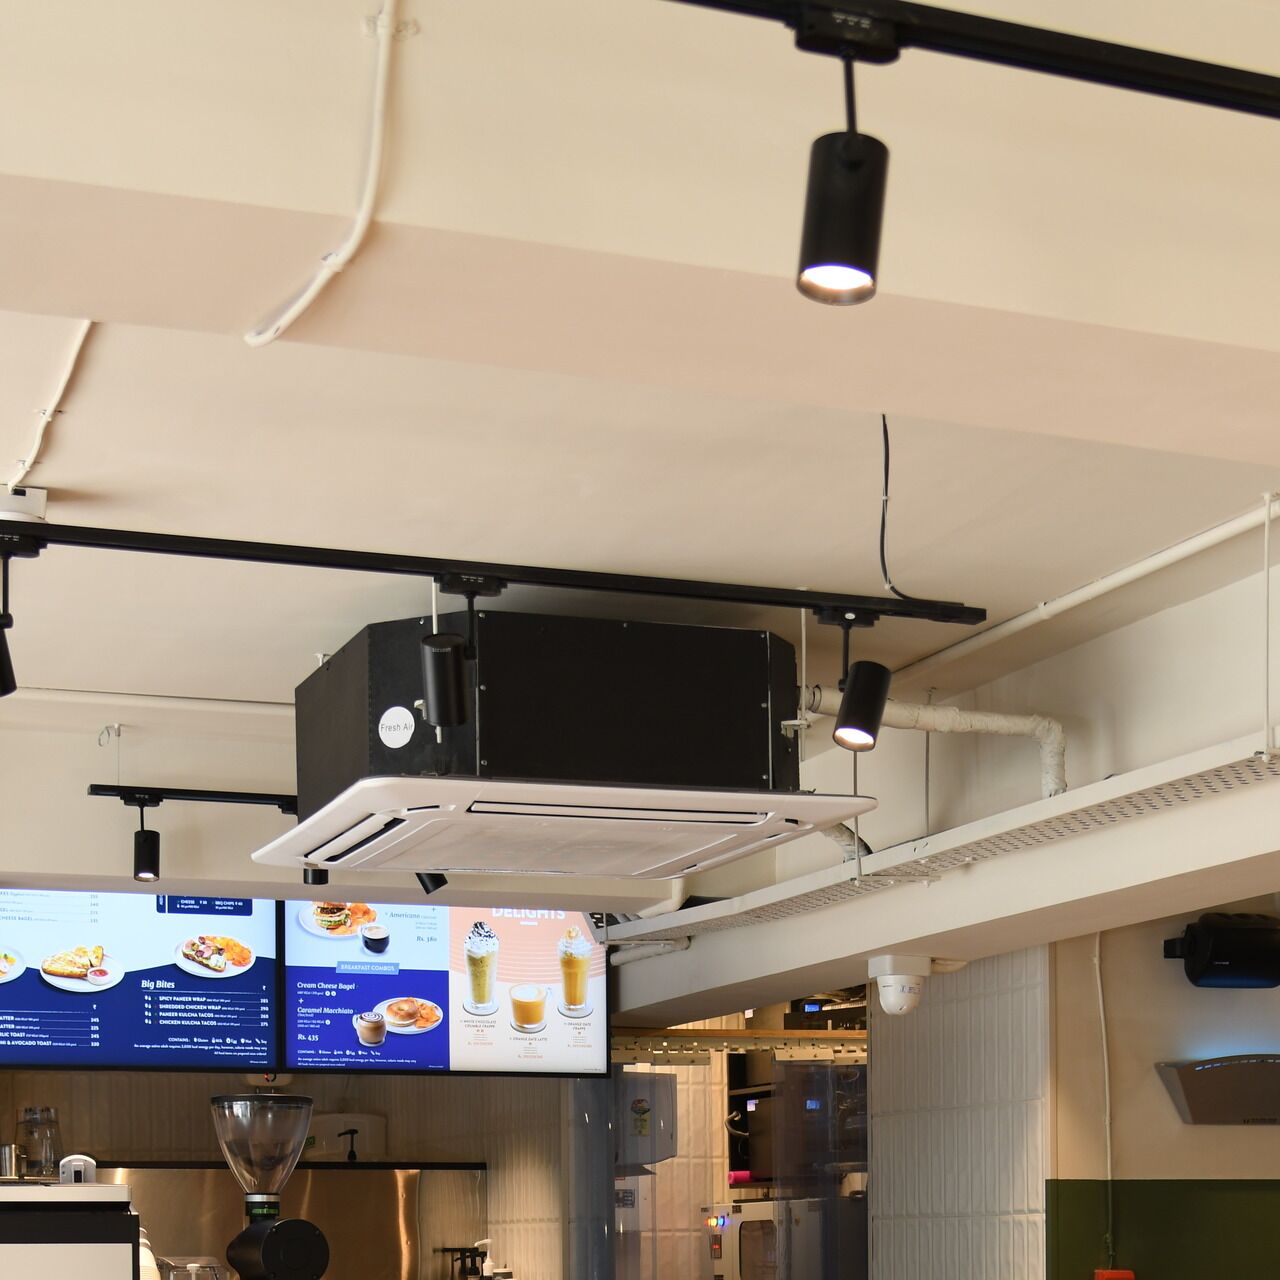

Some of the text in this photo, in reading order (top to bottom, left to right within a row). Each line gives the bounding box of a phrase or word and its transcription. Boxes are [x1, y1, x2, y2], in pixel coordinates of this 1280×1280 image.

[381, 724, 400, 732] Fresh
[141, 980, 175, 989] Big Bites
